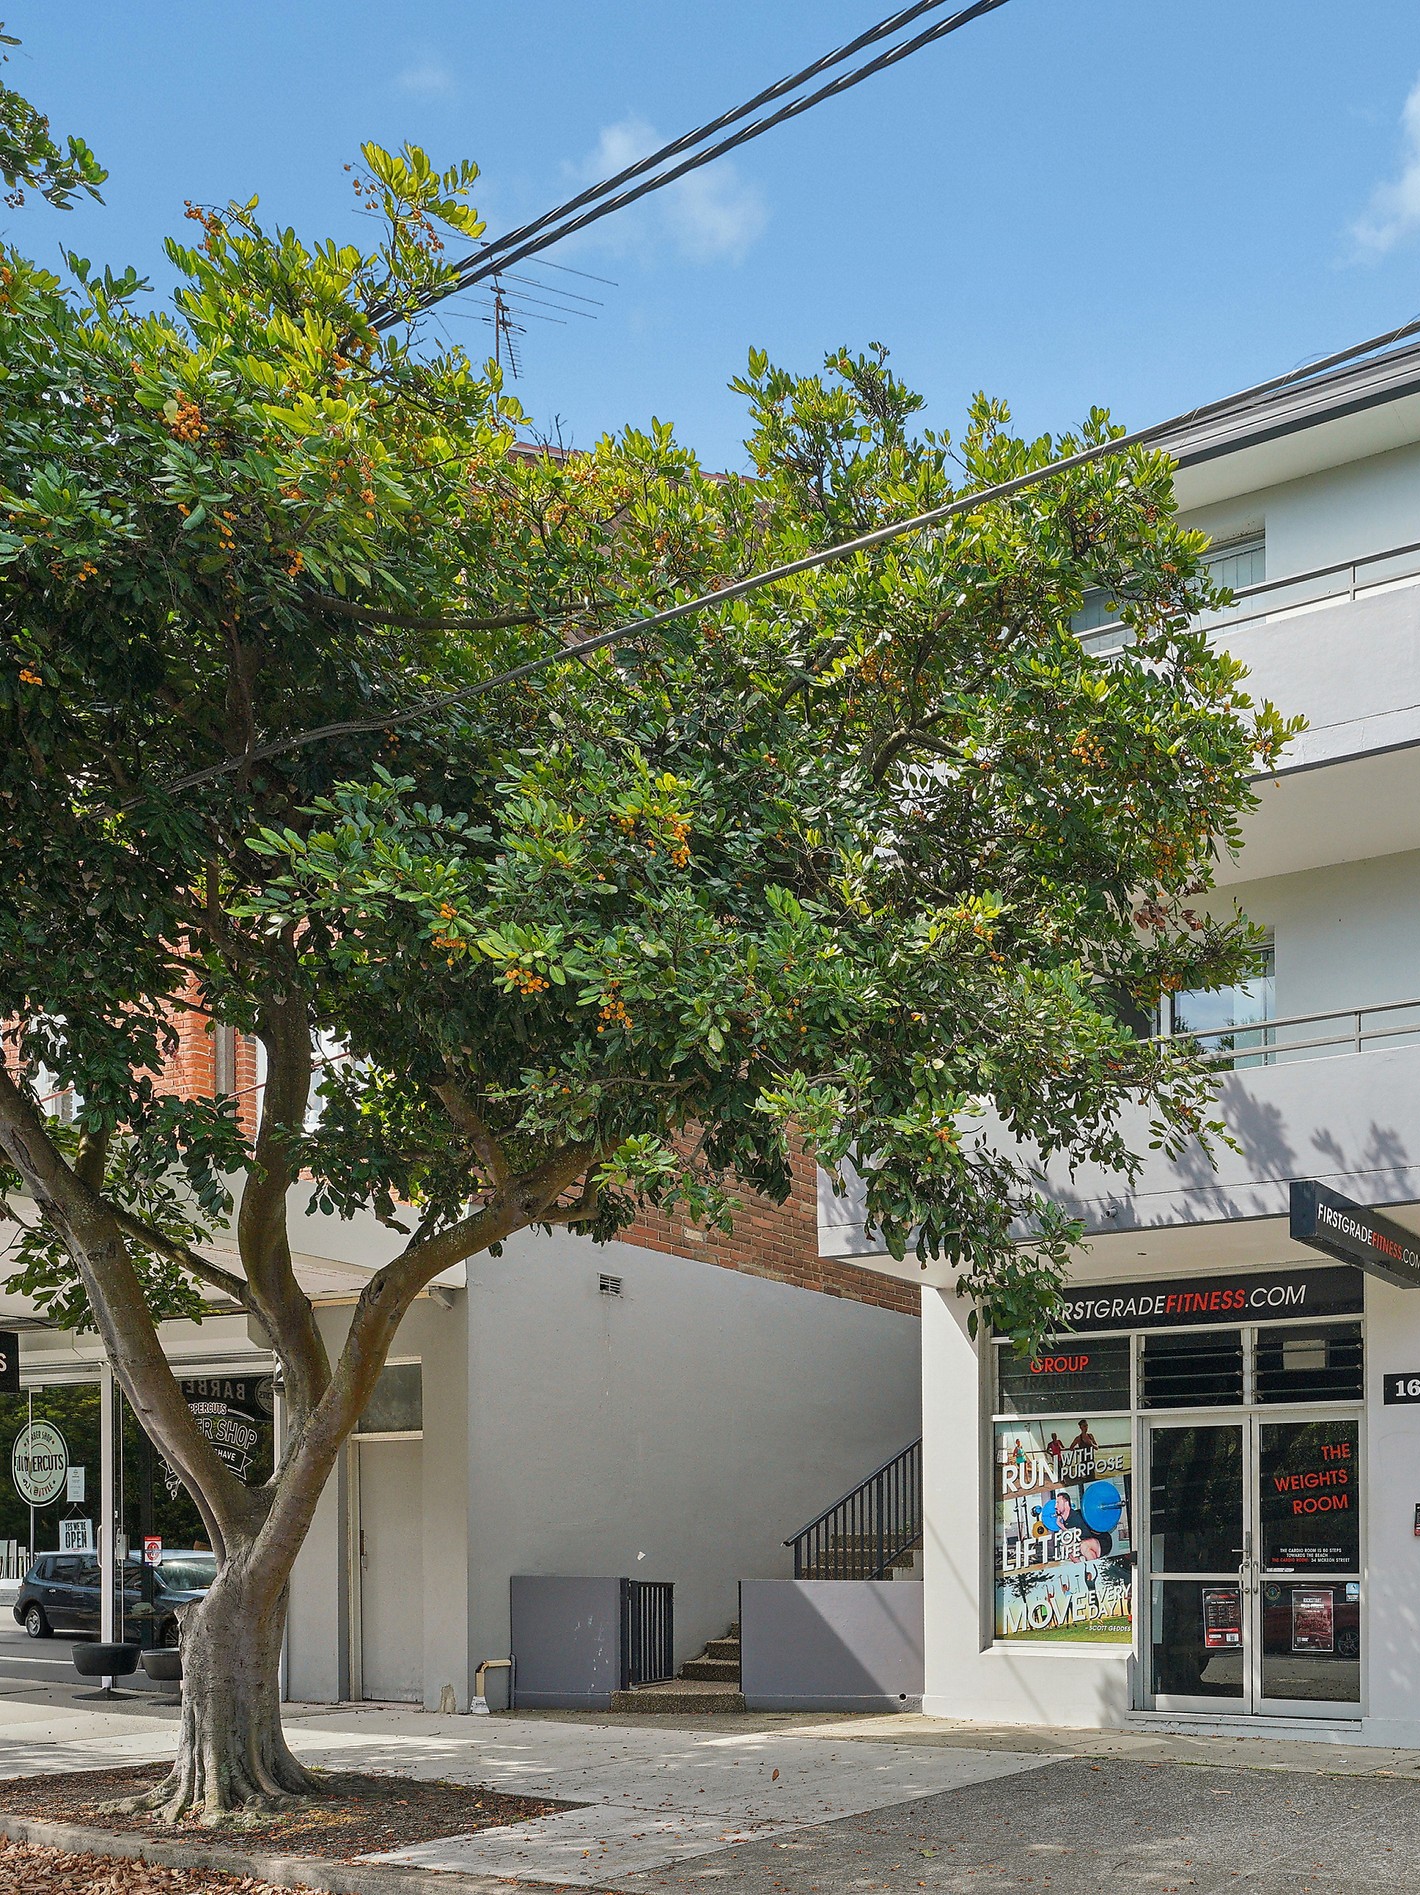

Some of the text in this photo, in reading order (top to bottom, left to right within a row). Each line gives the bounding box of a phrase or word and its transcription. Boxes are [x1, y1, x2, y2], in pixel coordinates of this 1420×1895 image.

[1045, 1284, 1307, 1322] IRSTGRADEFITNESS.COM
[1029, 1355, 1089, 1374] GROUP
[187, 1402, 228, 1415] PPERCUTS
[216, 1418, 258, 1450] SHOP
[214, 1448, 236, 1462] HAVE
[1061, 1447, 1094, 1466] WITH
[1320, 1443, 1351, 1460] THE
[1002, 1454, 1060, 1494] RUN
[1060, 1455, 1124, 1481] PURPOSE
[1273, 1469, 1348, 1492] WEIGHTS
[1292, 1494, 1349, 1515] ROOM
[64, 1520, 87, 1531] YES WE'RE
[65, 1530, 88, 1549] OPEN
[1053, 1528, 1082, 1547] FOR
[1002, 1535, 1053, 1572] LIFT
[1053, 1543, 1081, 1562] LIFE
[1089, 1583, 1131, 1605] EVERY
[1002, 1593, 1089, 1636] MOVE
[1089, 1601, 1118, 1621] DAY
